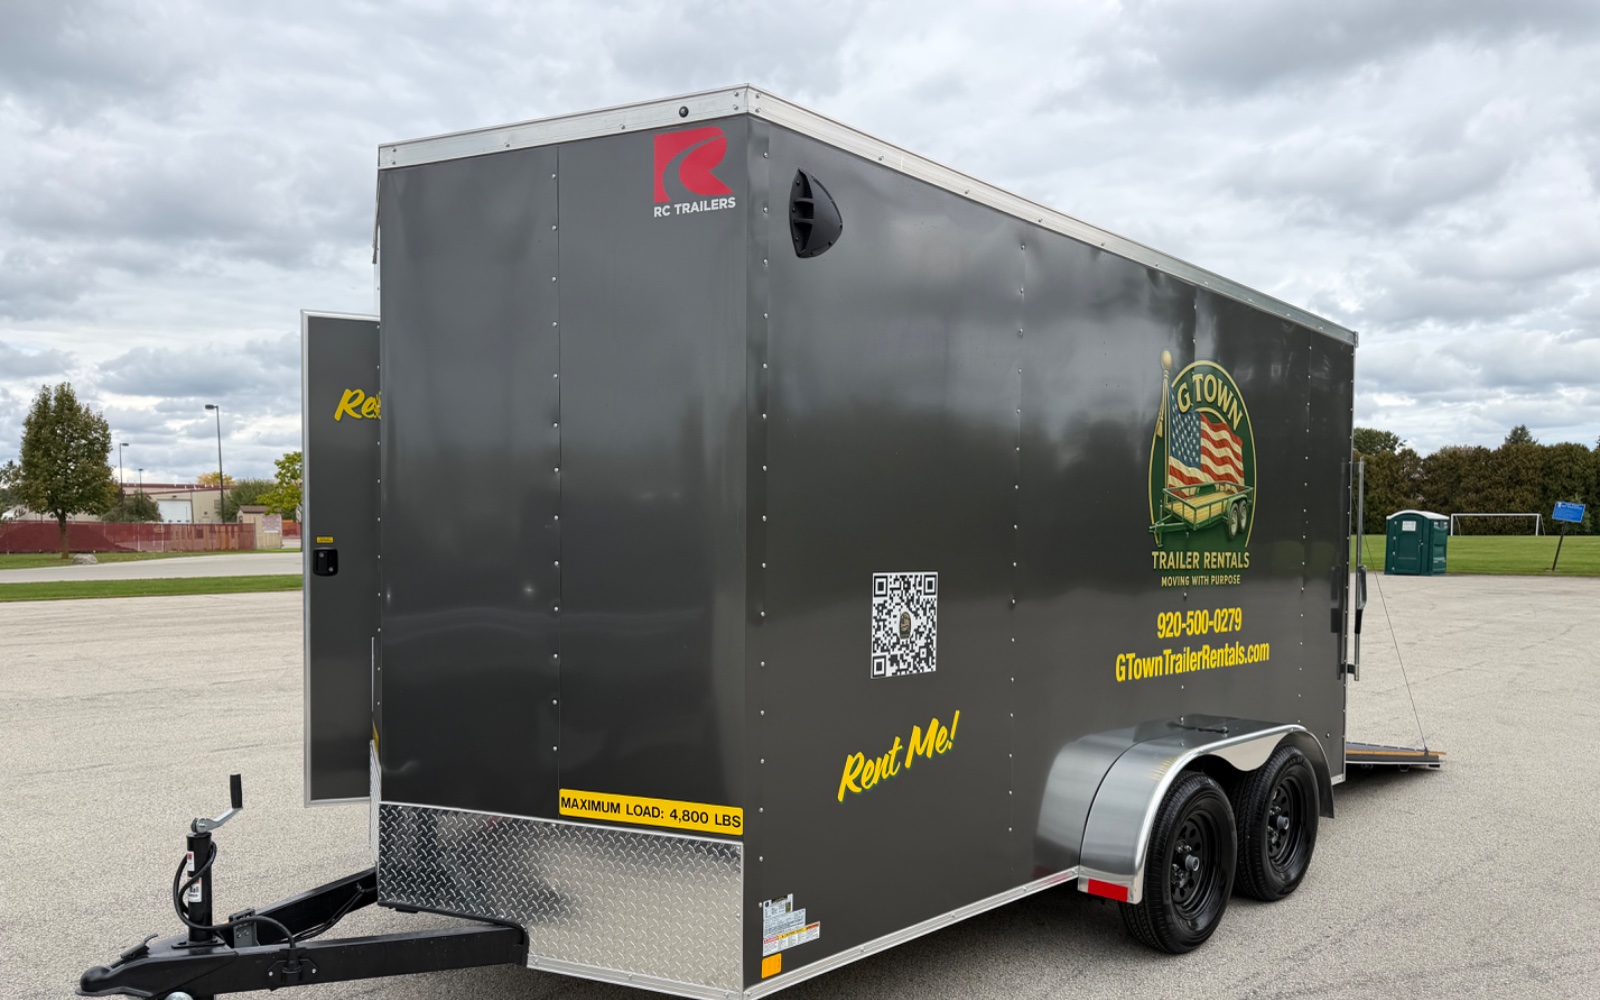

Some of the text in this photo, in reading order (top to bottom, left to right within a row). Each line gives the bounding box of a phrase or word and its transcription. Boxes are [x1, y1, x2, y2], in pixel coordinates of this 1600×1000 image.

[653, 196, 736, 218] RC TRAILERS
[1177, 373, 1243, 431] G TOWN
[1152, 551, 1250, 569] TRAILER RENTALS
[1161, 574, 1241, 587] MOVING WITH PURPOSE
[1157, 607, 1242, 639] 920-500-0279
[1115, 641, 1270, 682] GTownTrailerRentals.com
[837, 710, 960, 802] Rent Me!
[561, 796, 741, 828] MAXIMUM LOAD: 4,800 LBS
